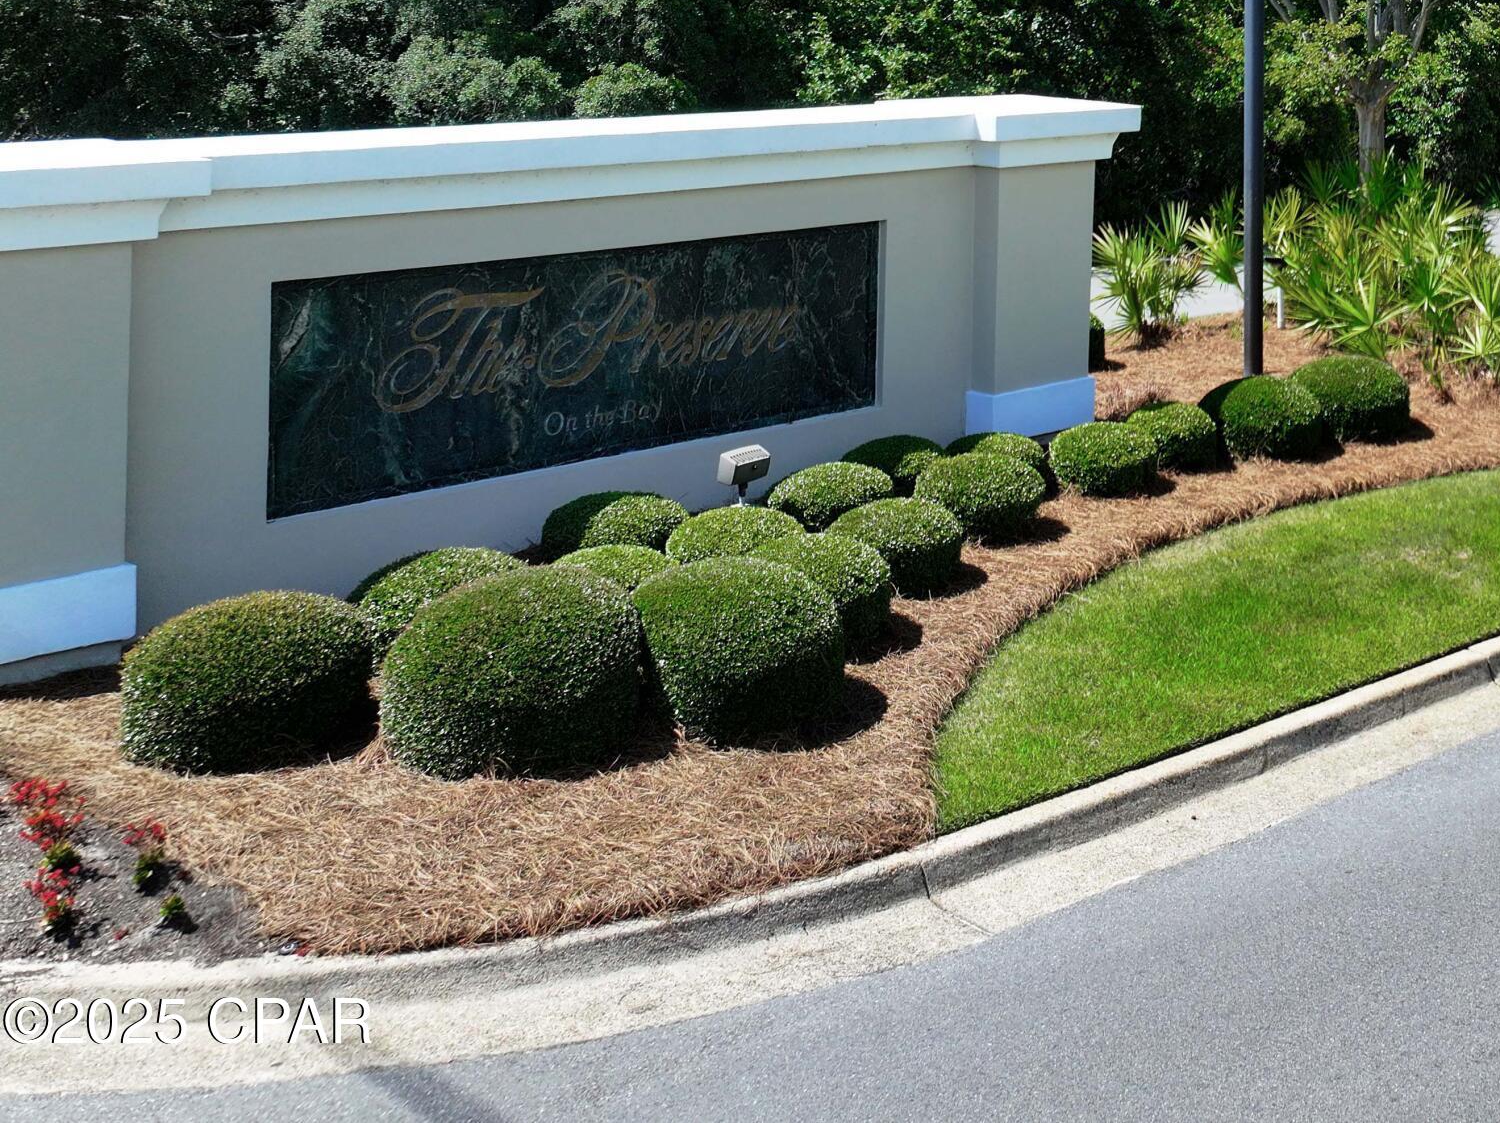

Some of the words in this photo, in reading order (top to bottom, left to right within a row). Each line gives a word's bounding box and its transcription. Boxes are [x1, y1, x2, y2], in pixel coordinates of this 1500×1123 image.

[373, 287, 545, 413] The
[537, 268, 801, 388] Preserve
[544, 409, 578, 438] On
[584, 403, 615, 430] the
[619, 400, 662, 426] Bay
